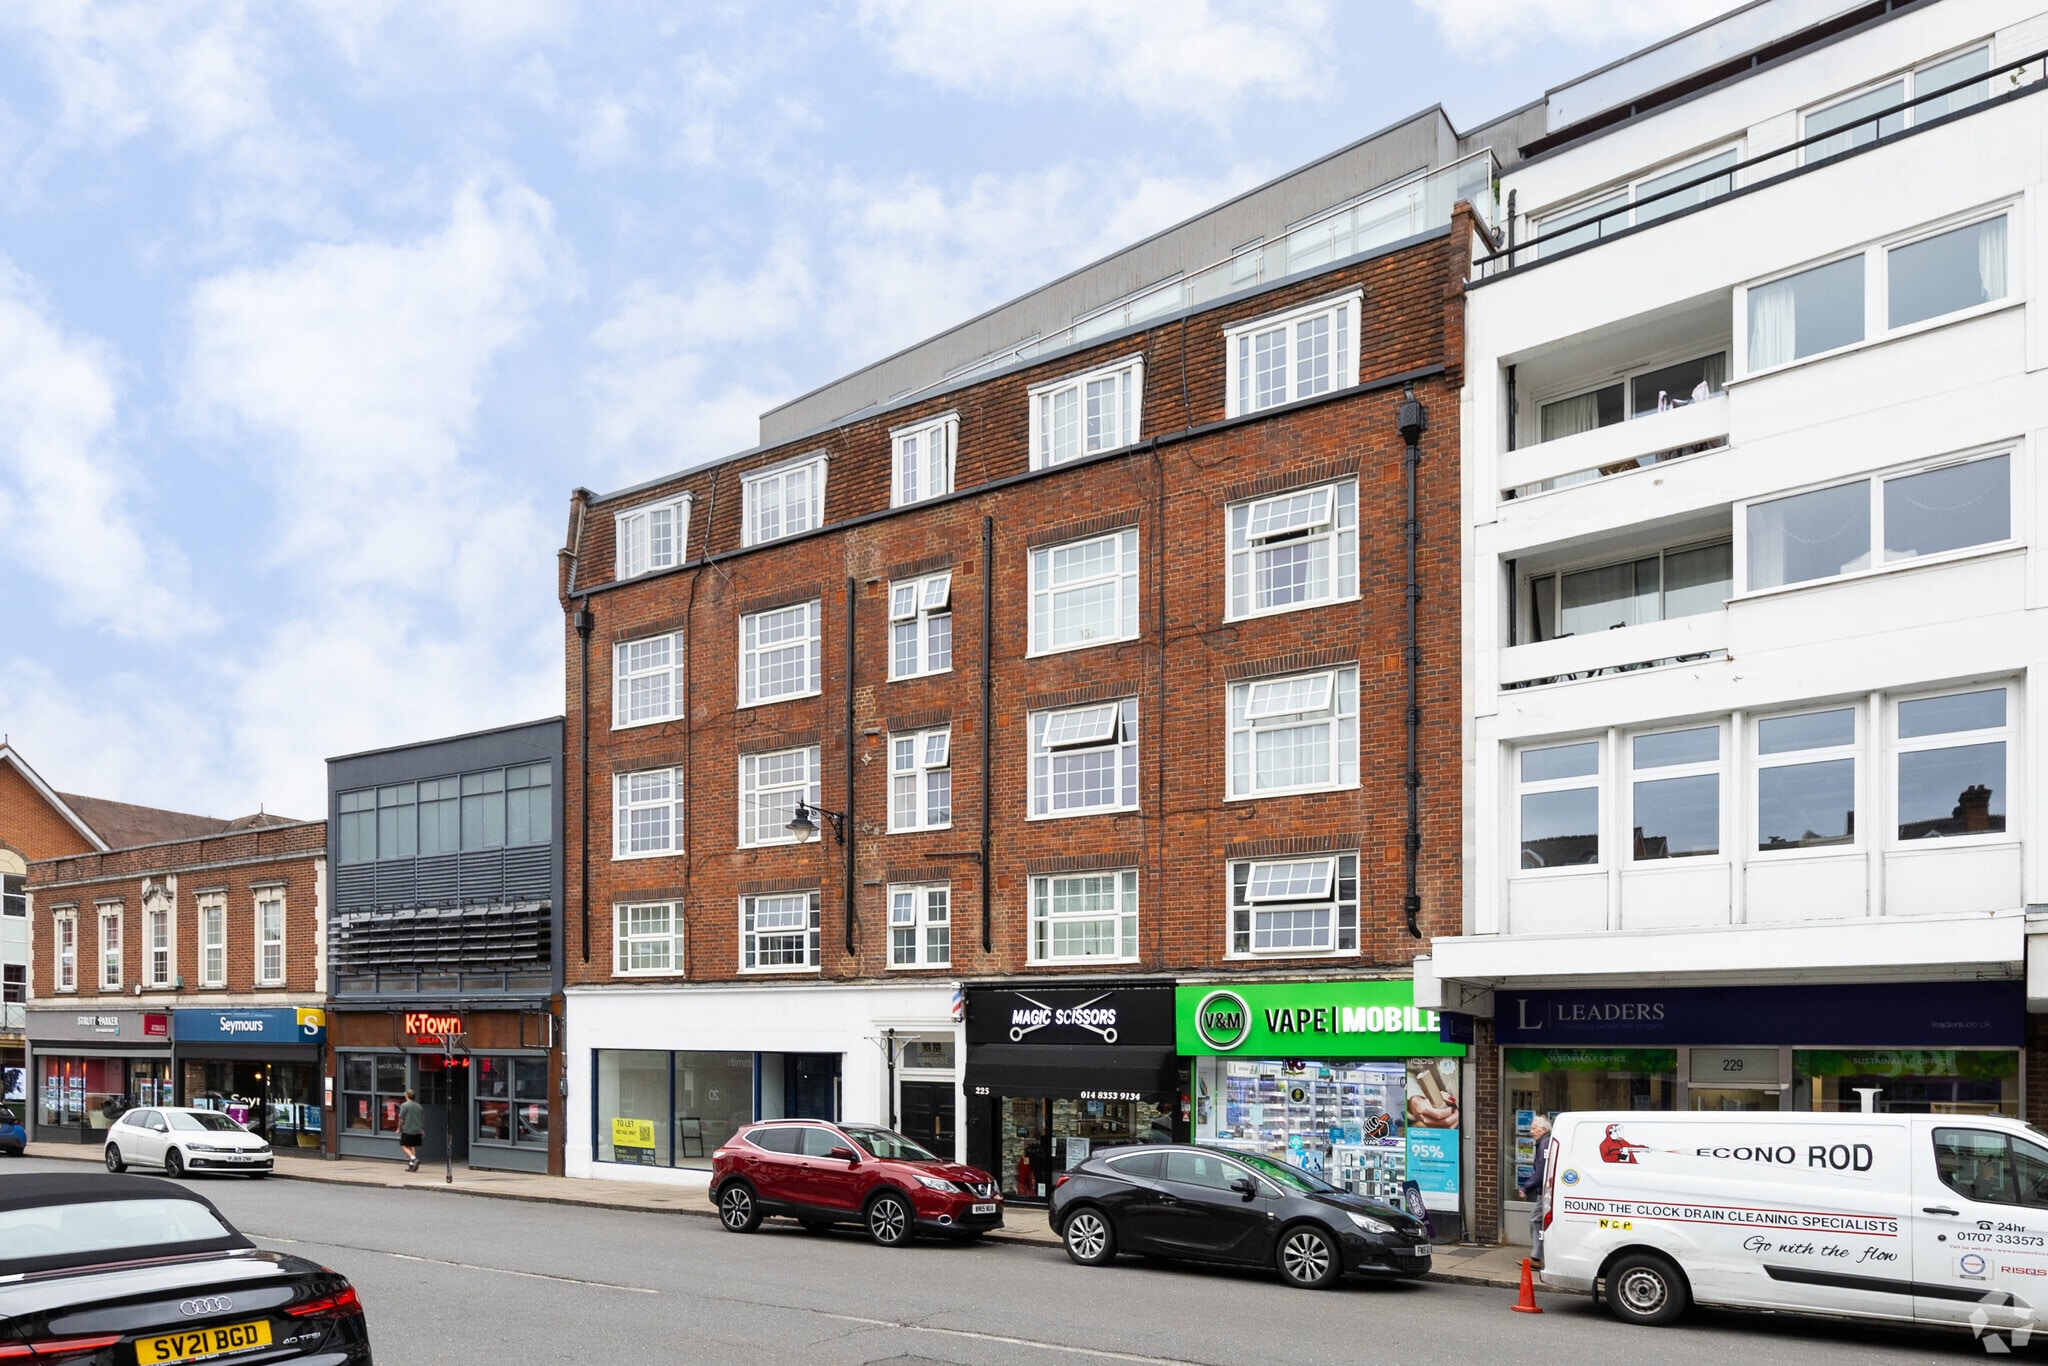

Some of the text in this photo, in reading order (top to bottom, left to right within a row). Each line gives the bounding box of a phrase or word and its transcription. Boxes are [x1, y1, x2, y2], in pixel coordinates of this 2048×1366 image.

[1012, 1008, 1117, 1025] MAGIC SCISSORS
[1204, 1012, 1241, 1029] V&M
[1264, 1006, 1441, 1033] VAPE MOBILE
[1516, 999, 1543, 1029] L
[1558, 1003, 1665, 1021] LEADERS
[77, 1016, 96, 1026] STRUTT
[99, 1016, 119, 1026] PARKER
[220, 1016, 263, 1035] Seymours
[303, 1015, 318, 1035] S
[405, 1013, 461, 1034] K-Town
[1723, 1059, 1743, 1071] 229
[1852, 1058, 1952, 1066] SUSTAINABLE OFFICE
[975, 1087, 990, 1095] 225
[1081, 1091, 1141, 1101] 014 8353 9134
[616, 1119, 634, 1128] TO LET
[1411, 1143, 1444, 1159] 95%
[1696, 1144, 1873, 1172] ECONO ROD
[1564, 1200, 1898, 1232] ROUND THE CLOCK DRAIN CLEANING SPECIALISTS
[1997, 1222, 2026, 1232] 24hr
[1957, 1232, 2044, 1246] 01707 333573
[1743, 1235, 1898, 1263] Go with the flow
[154, 1325, 258, 1361] SV21 BGD
